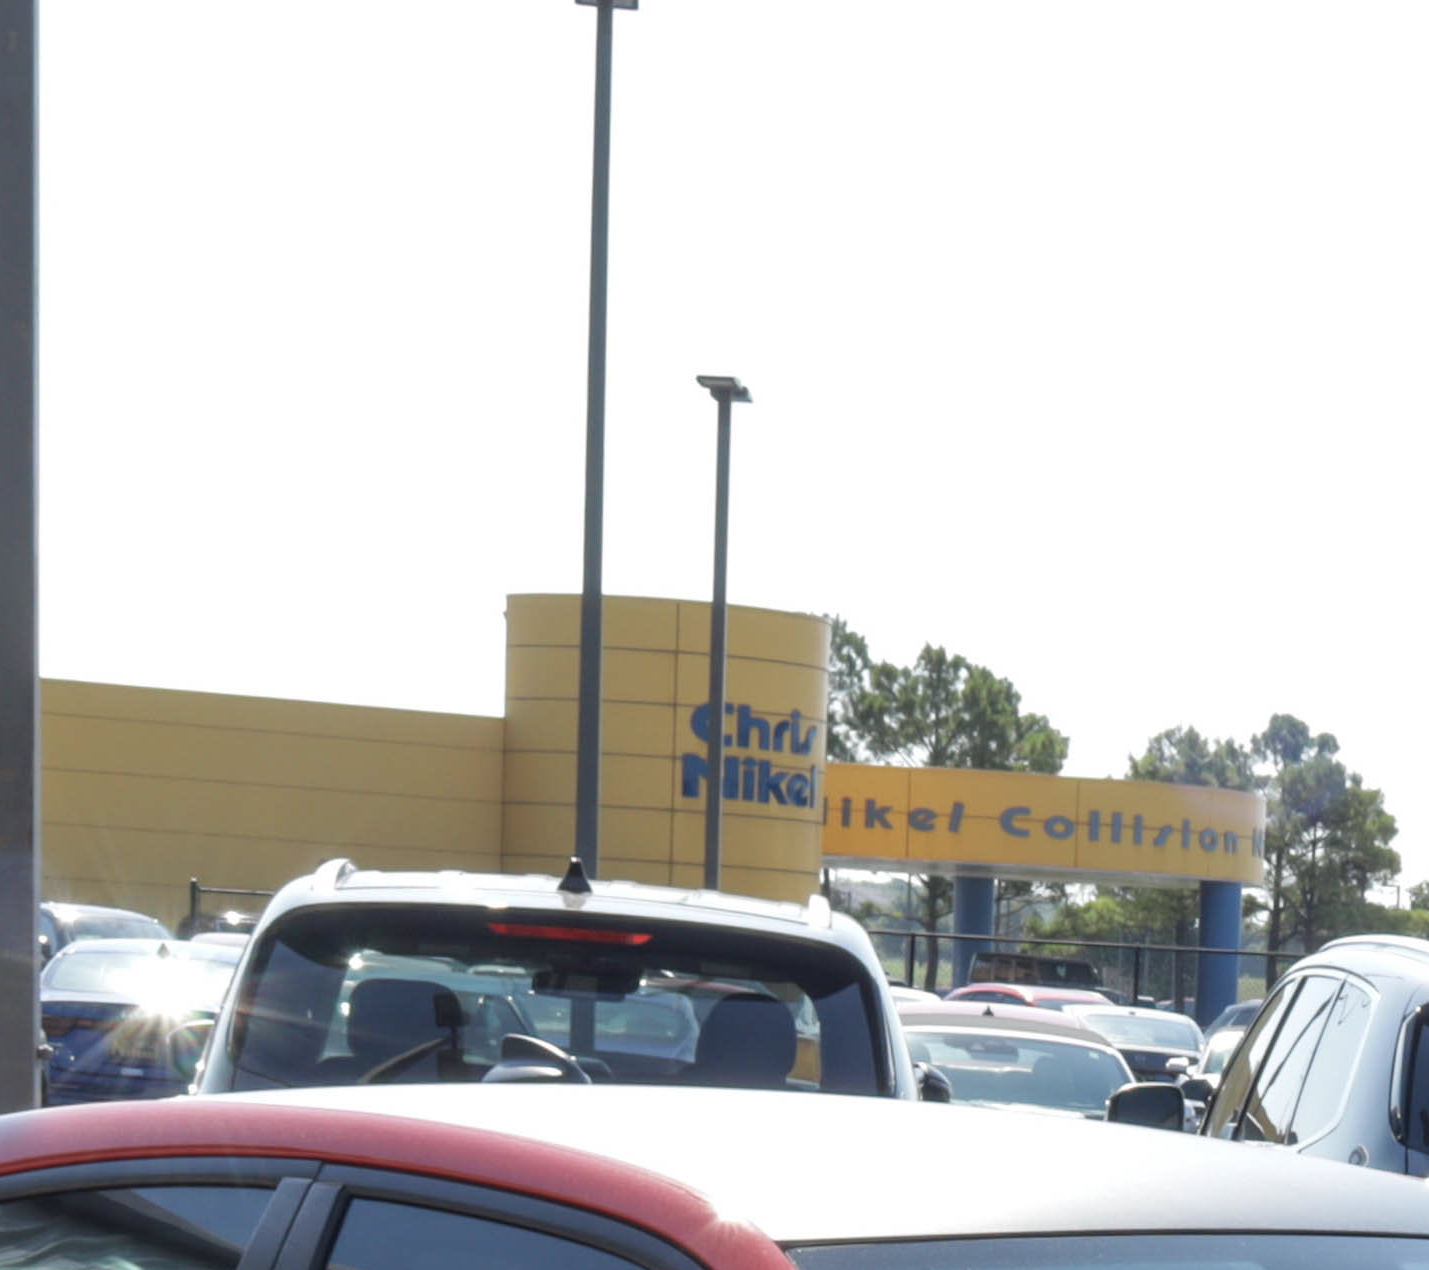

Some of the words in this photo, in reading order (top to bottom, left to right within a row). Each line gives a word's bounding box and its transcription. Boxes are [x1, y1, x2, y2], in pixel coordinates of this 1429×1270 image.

[690, 702, 818, 755] Chris
[682, 753, 819, 809] Nikel
[999, 806, 1240, 854] Collision
